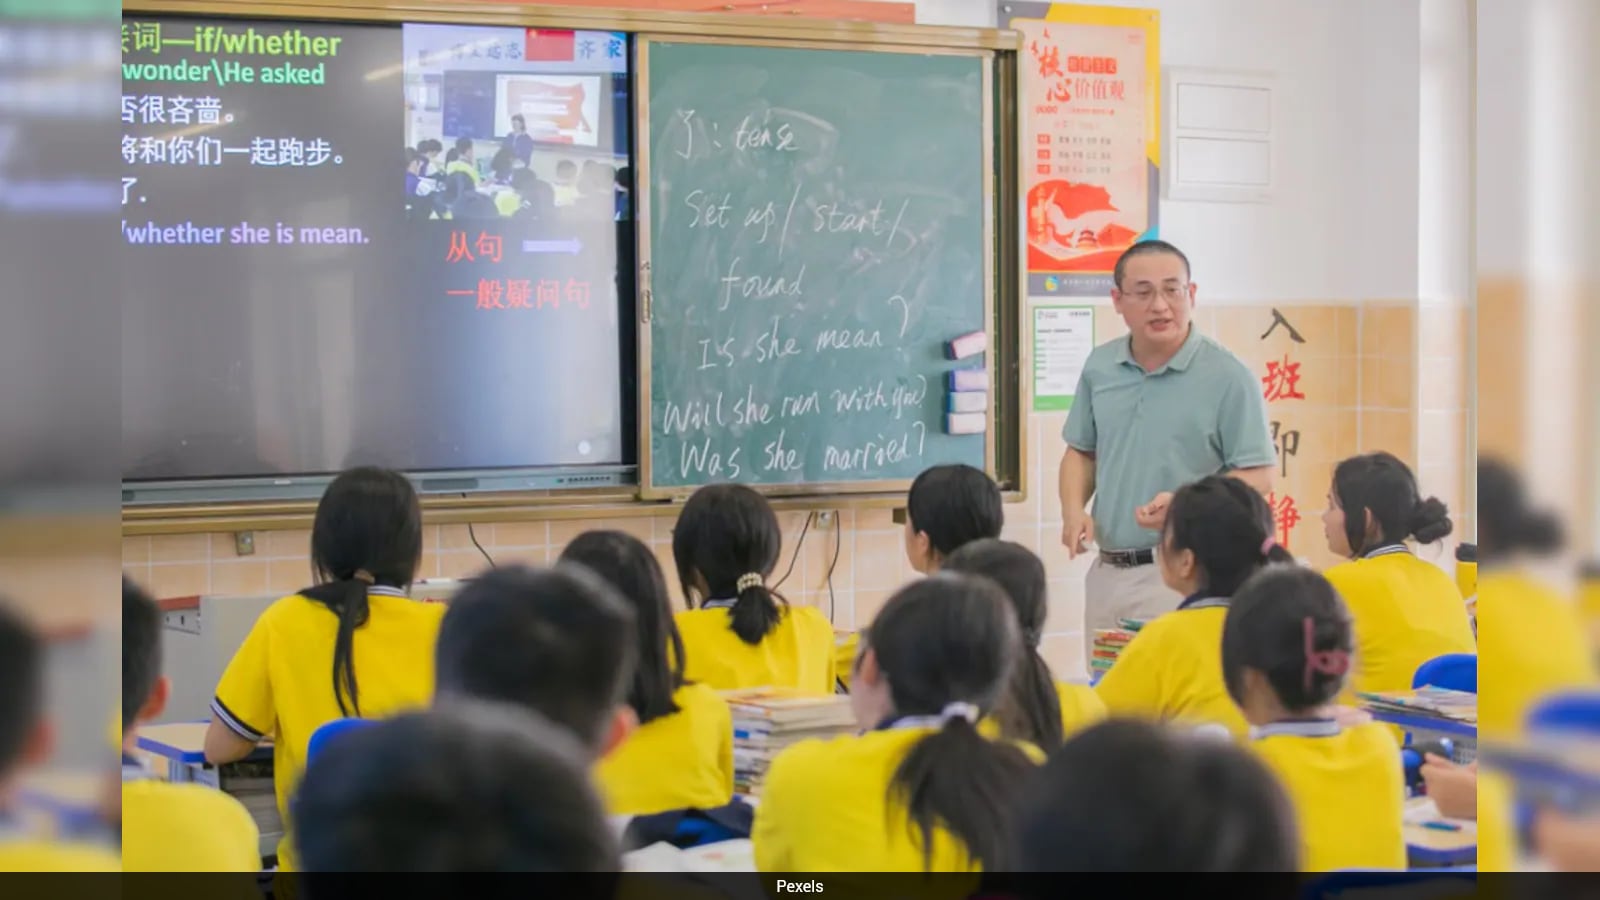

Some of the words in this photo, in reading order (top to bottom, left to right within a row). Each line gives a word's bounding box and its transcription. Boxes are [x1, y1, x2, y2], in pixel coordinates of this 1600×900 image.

[260, 61, 326, 85] asked
[735, 115, 800, 151] tense
[685, 189, 731, 228] Set
[230, 222, 271, 244] she
[276, 222, 294, 244] is
[300, 227, 370, 244] mean.
[446, 231, 503, 263] 从句
[446, 278, 592, 310] 一般疑问句
[719, 257, 805, 311] found
[697, 338, 734, 370] Is
[757, 314, 801, 363] she
[663, 391, 724, 435] Will
[736, 383, 774, 425] she
[780, 391, 821, 419] run
[834, 380, 887, 412] with
[680, 438, 741, 479] Was
[764, 429, 802, 472] she
